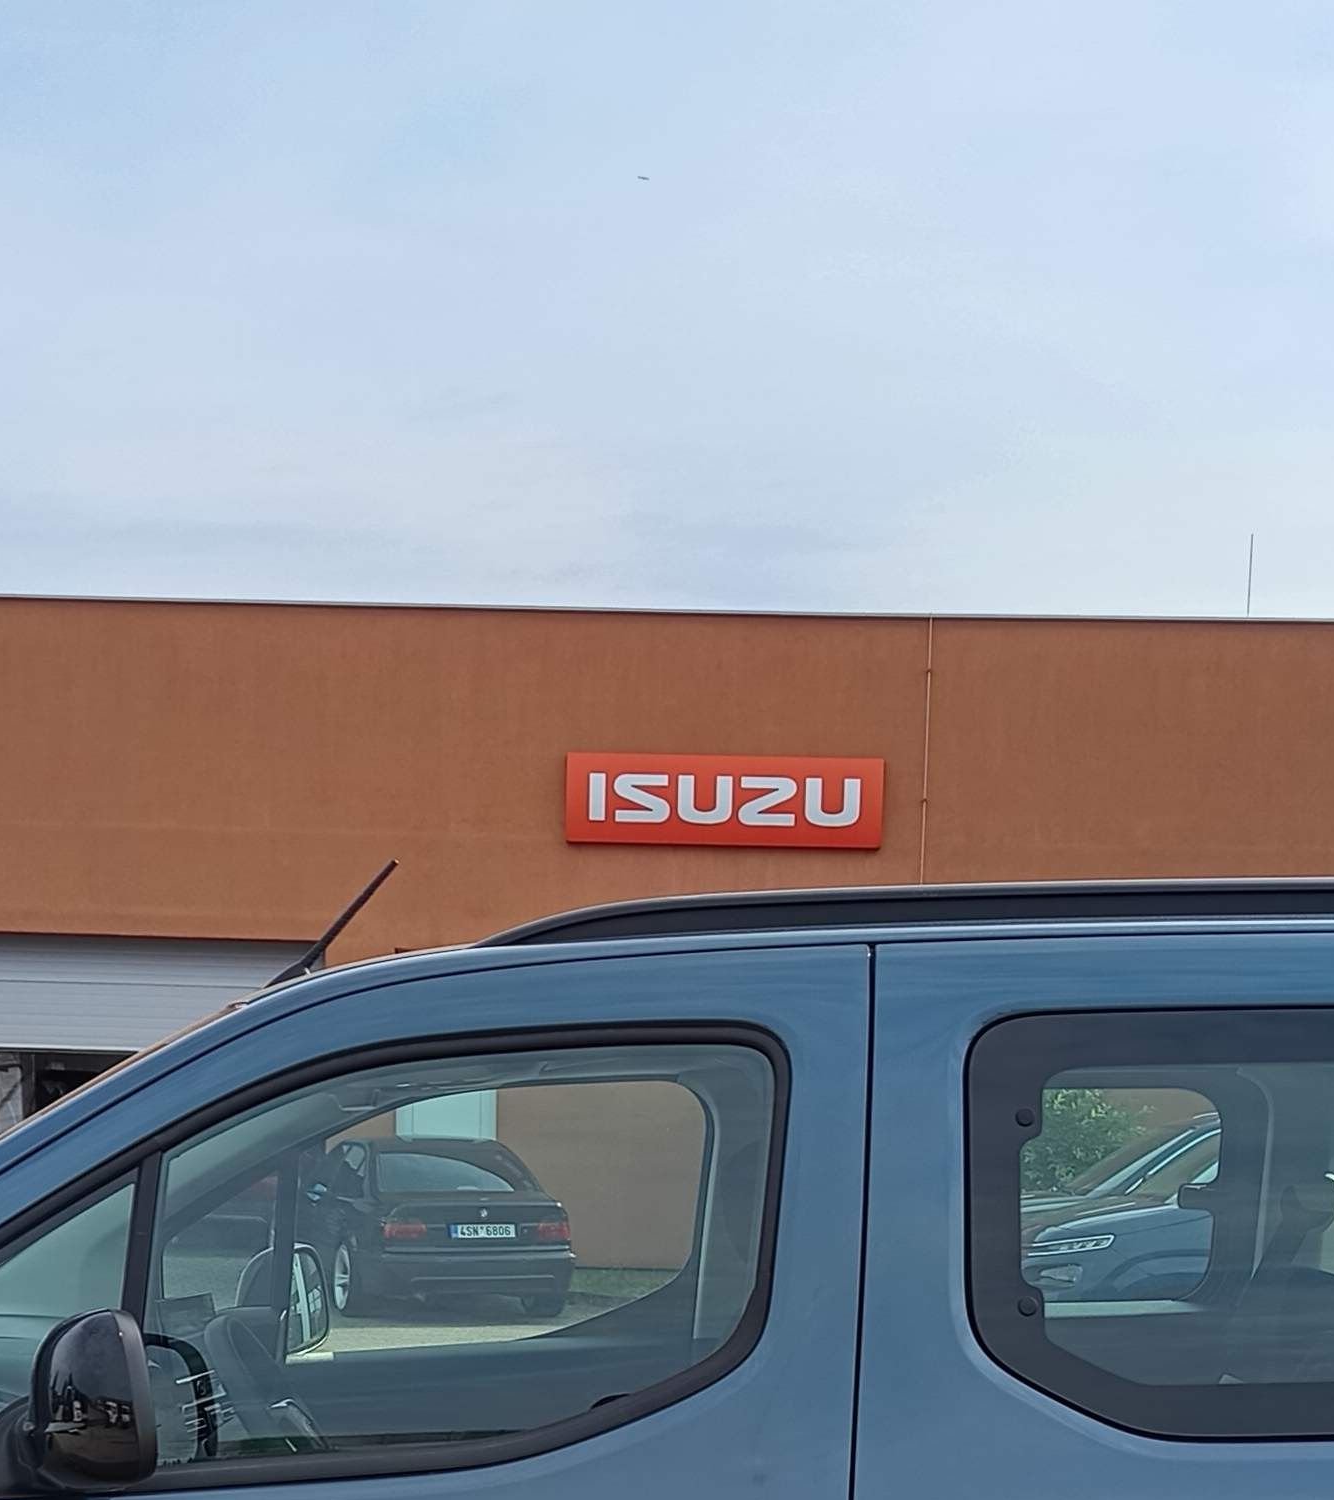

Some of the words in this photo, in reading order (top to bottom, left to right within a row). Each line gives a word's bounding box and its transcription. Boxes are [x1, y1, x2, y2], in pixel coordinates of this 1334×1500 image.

[588, 771, 862, 828] ISUZU
[460, 1226, 479, 1236] 4SN
[485, 1225, 511, 1237] 6806
